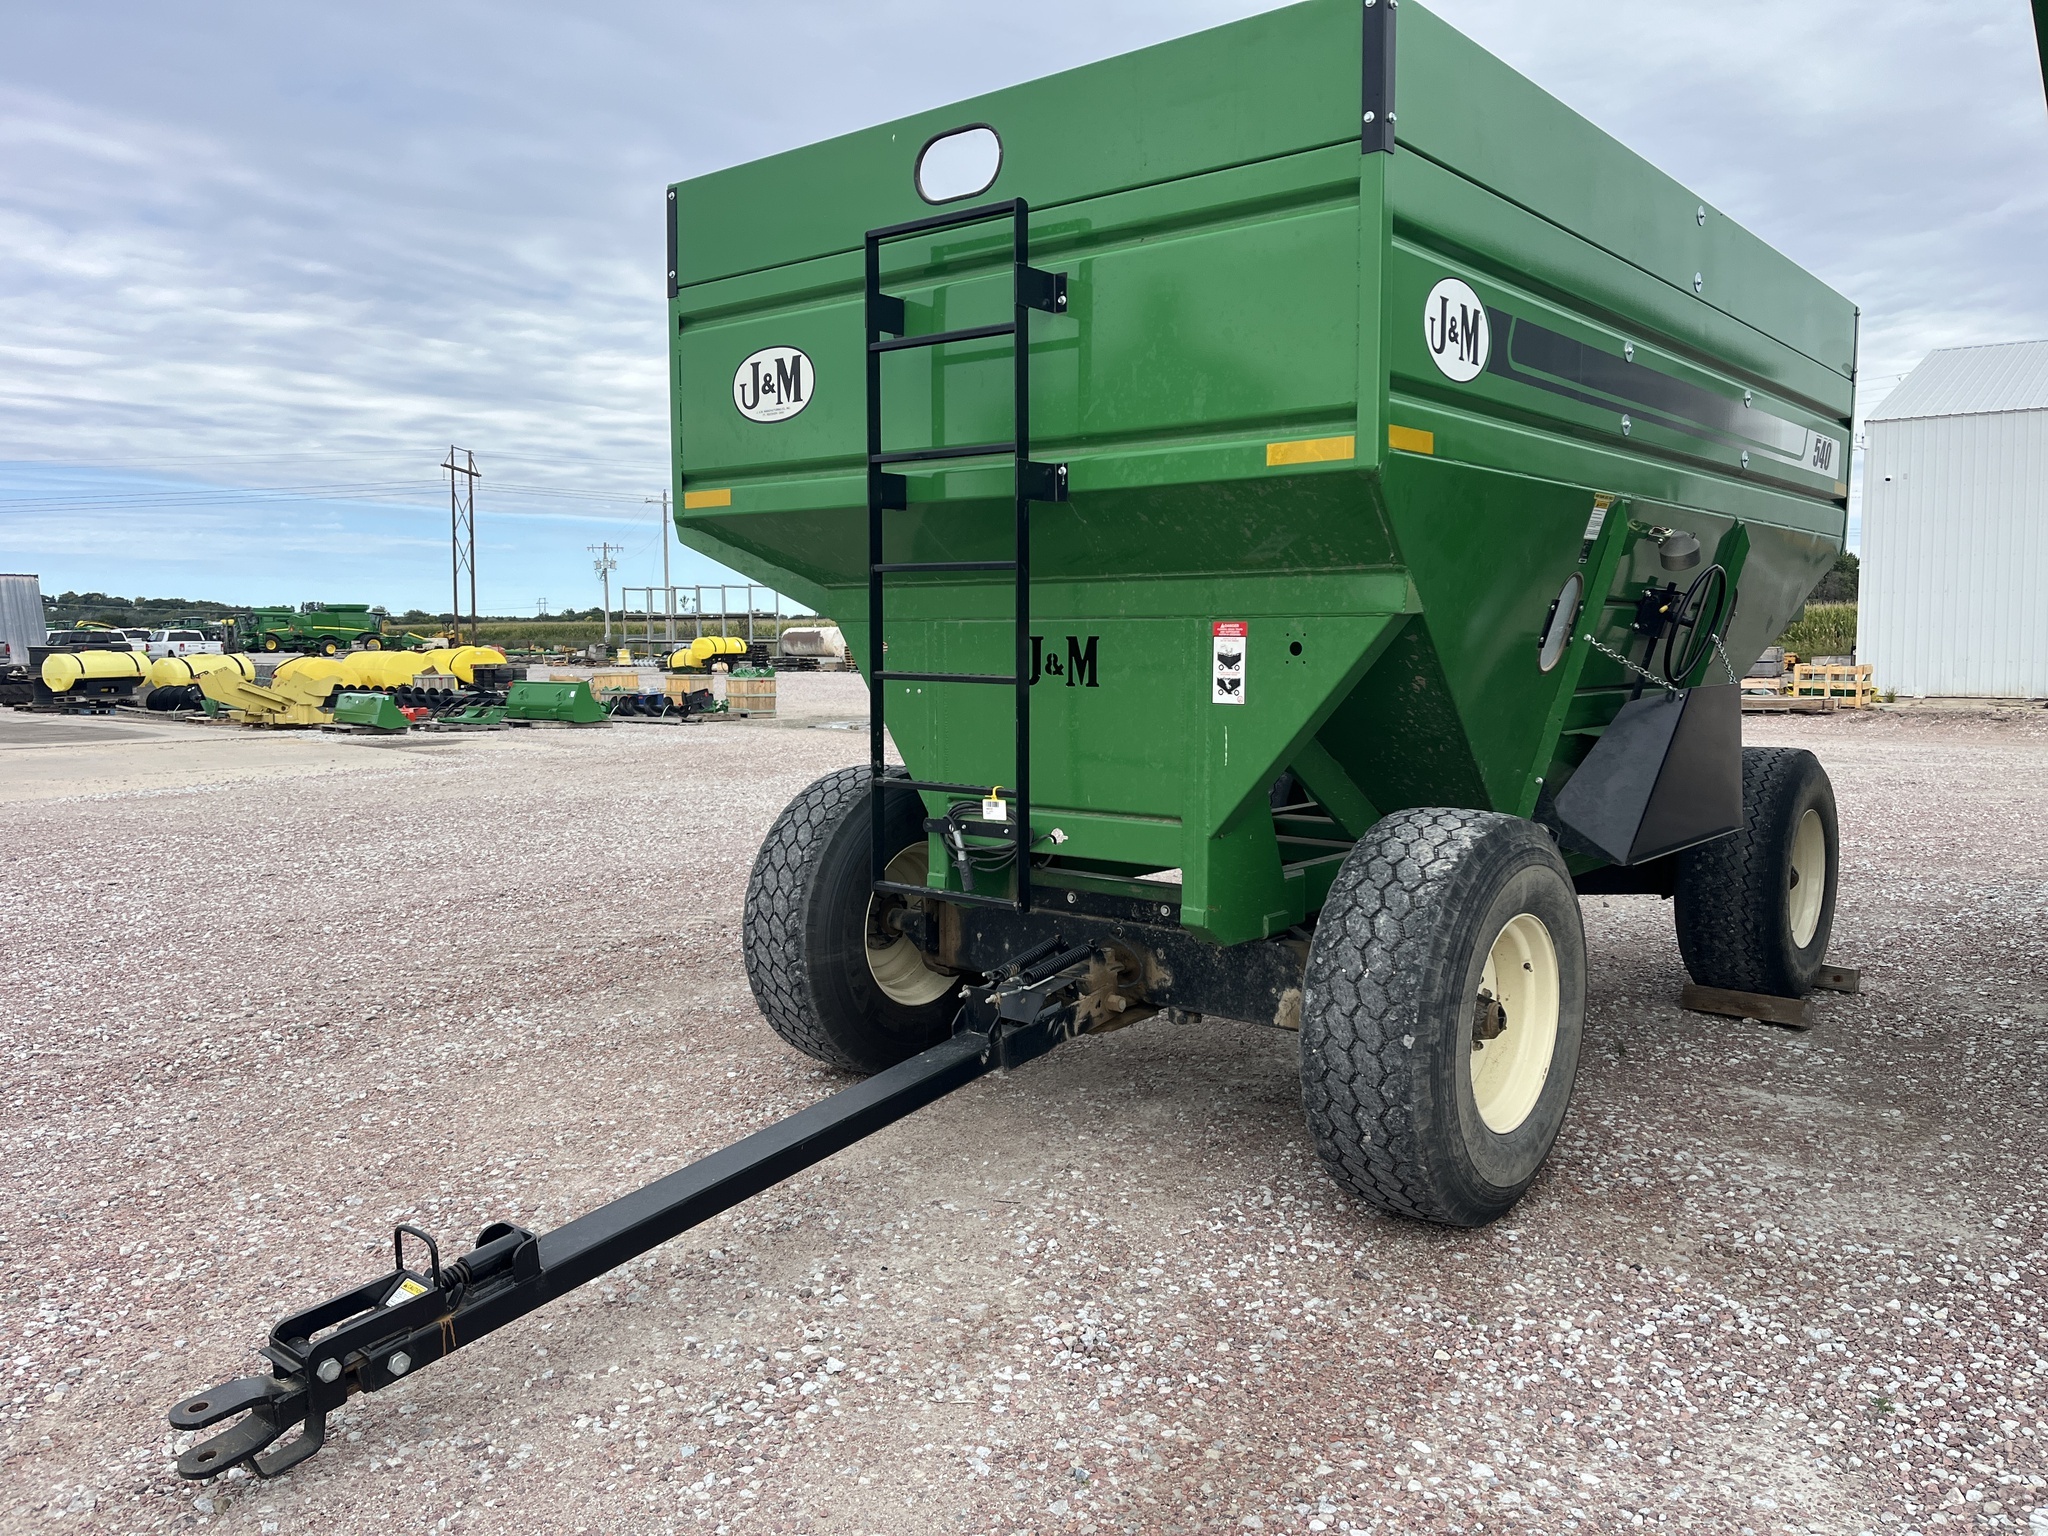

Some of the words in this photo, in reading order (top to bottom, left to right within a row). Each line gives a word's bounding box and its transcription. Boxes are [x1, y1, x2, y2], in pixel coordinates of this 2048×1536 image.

[1430, 295, 1480, 366] J&M
[739, 354, 804, 410] J&M
[1812, 438, 1832, 470] 540
